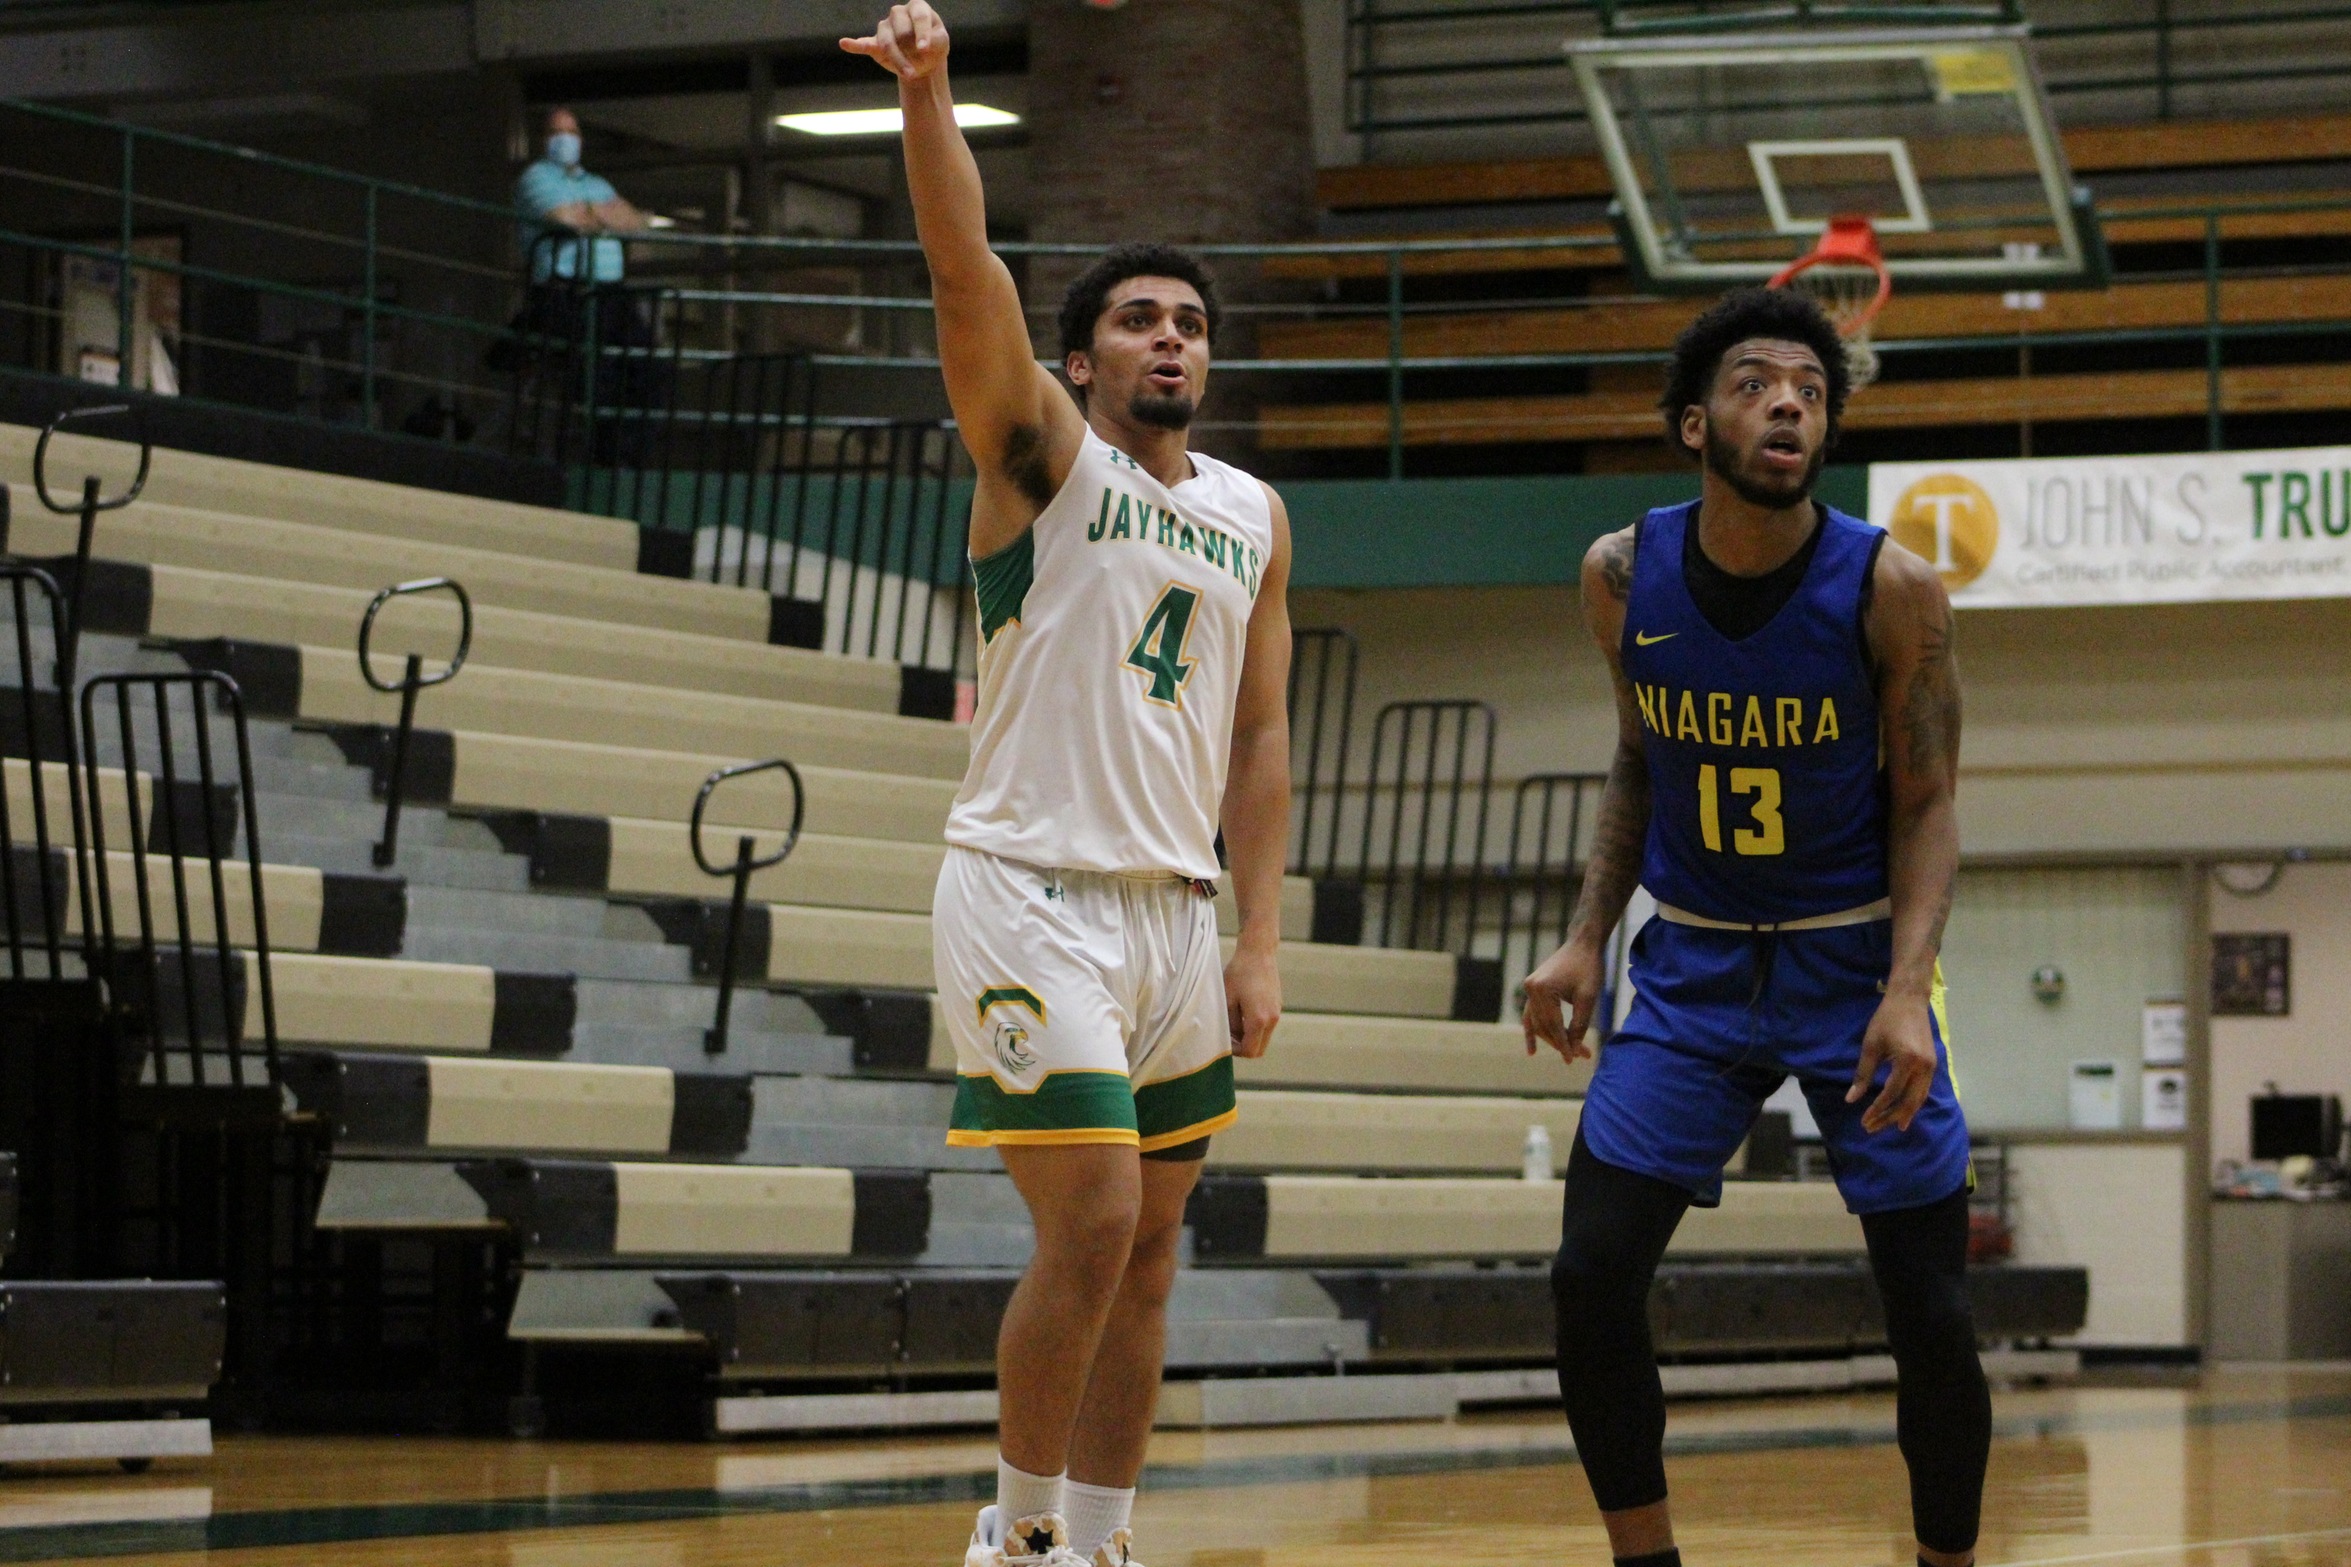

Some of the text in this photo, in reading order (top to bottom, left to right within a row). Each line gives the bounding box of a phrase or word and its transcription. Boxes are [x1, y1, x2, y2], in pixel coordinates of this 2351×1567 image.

[1087, 486, 1260, 601] JAYHAWKS
[1911, 494, 1977, 573] T
[2018, 468, 2351, 550] JOHN S. TRU
[2015, 560, 2120, 585] Certified
[2126, 557, 2200, 582] Public
[1119, 579, 1204, 713] 4
[1635, 681, 1840, 748] NIAGARA
[1697, 763, 1785, 856] 13
